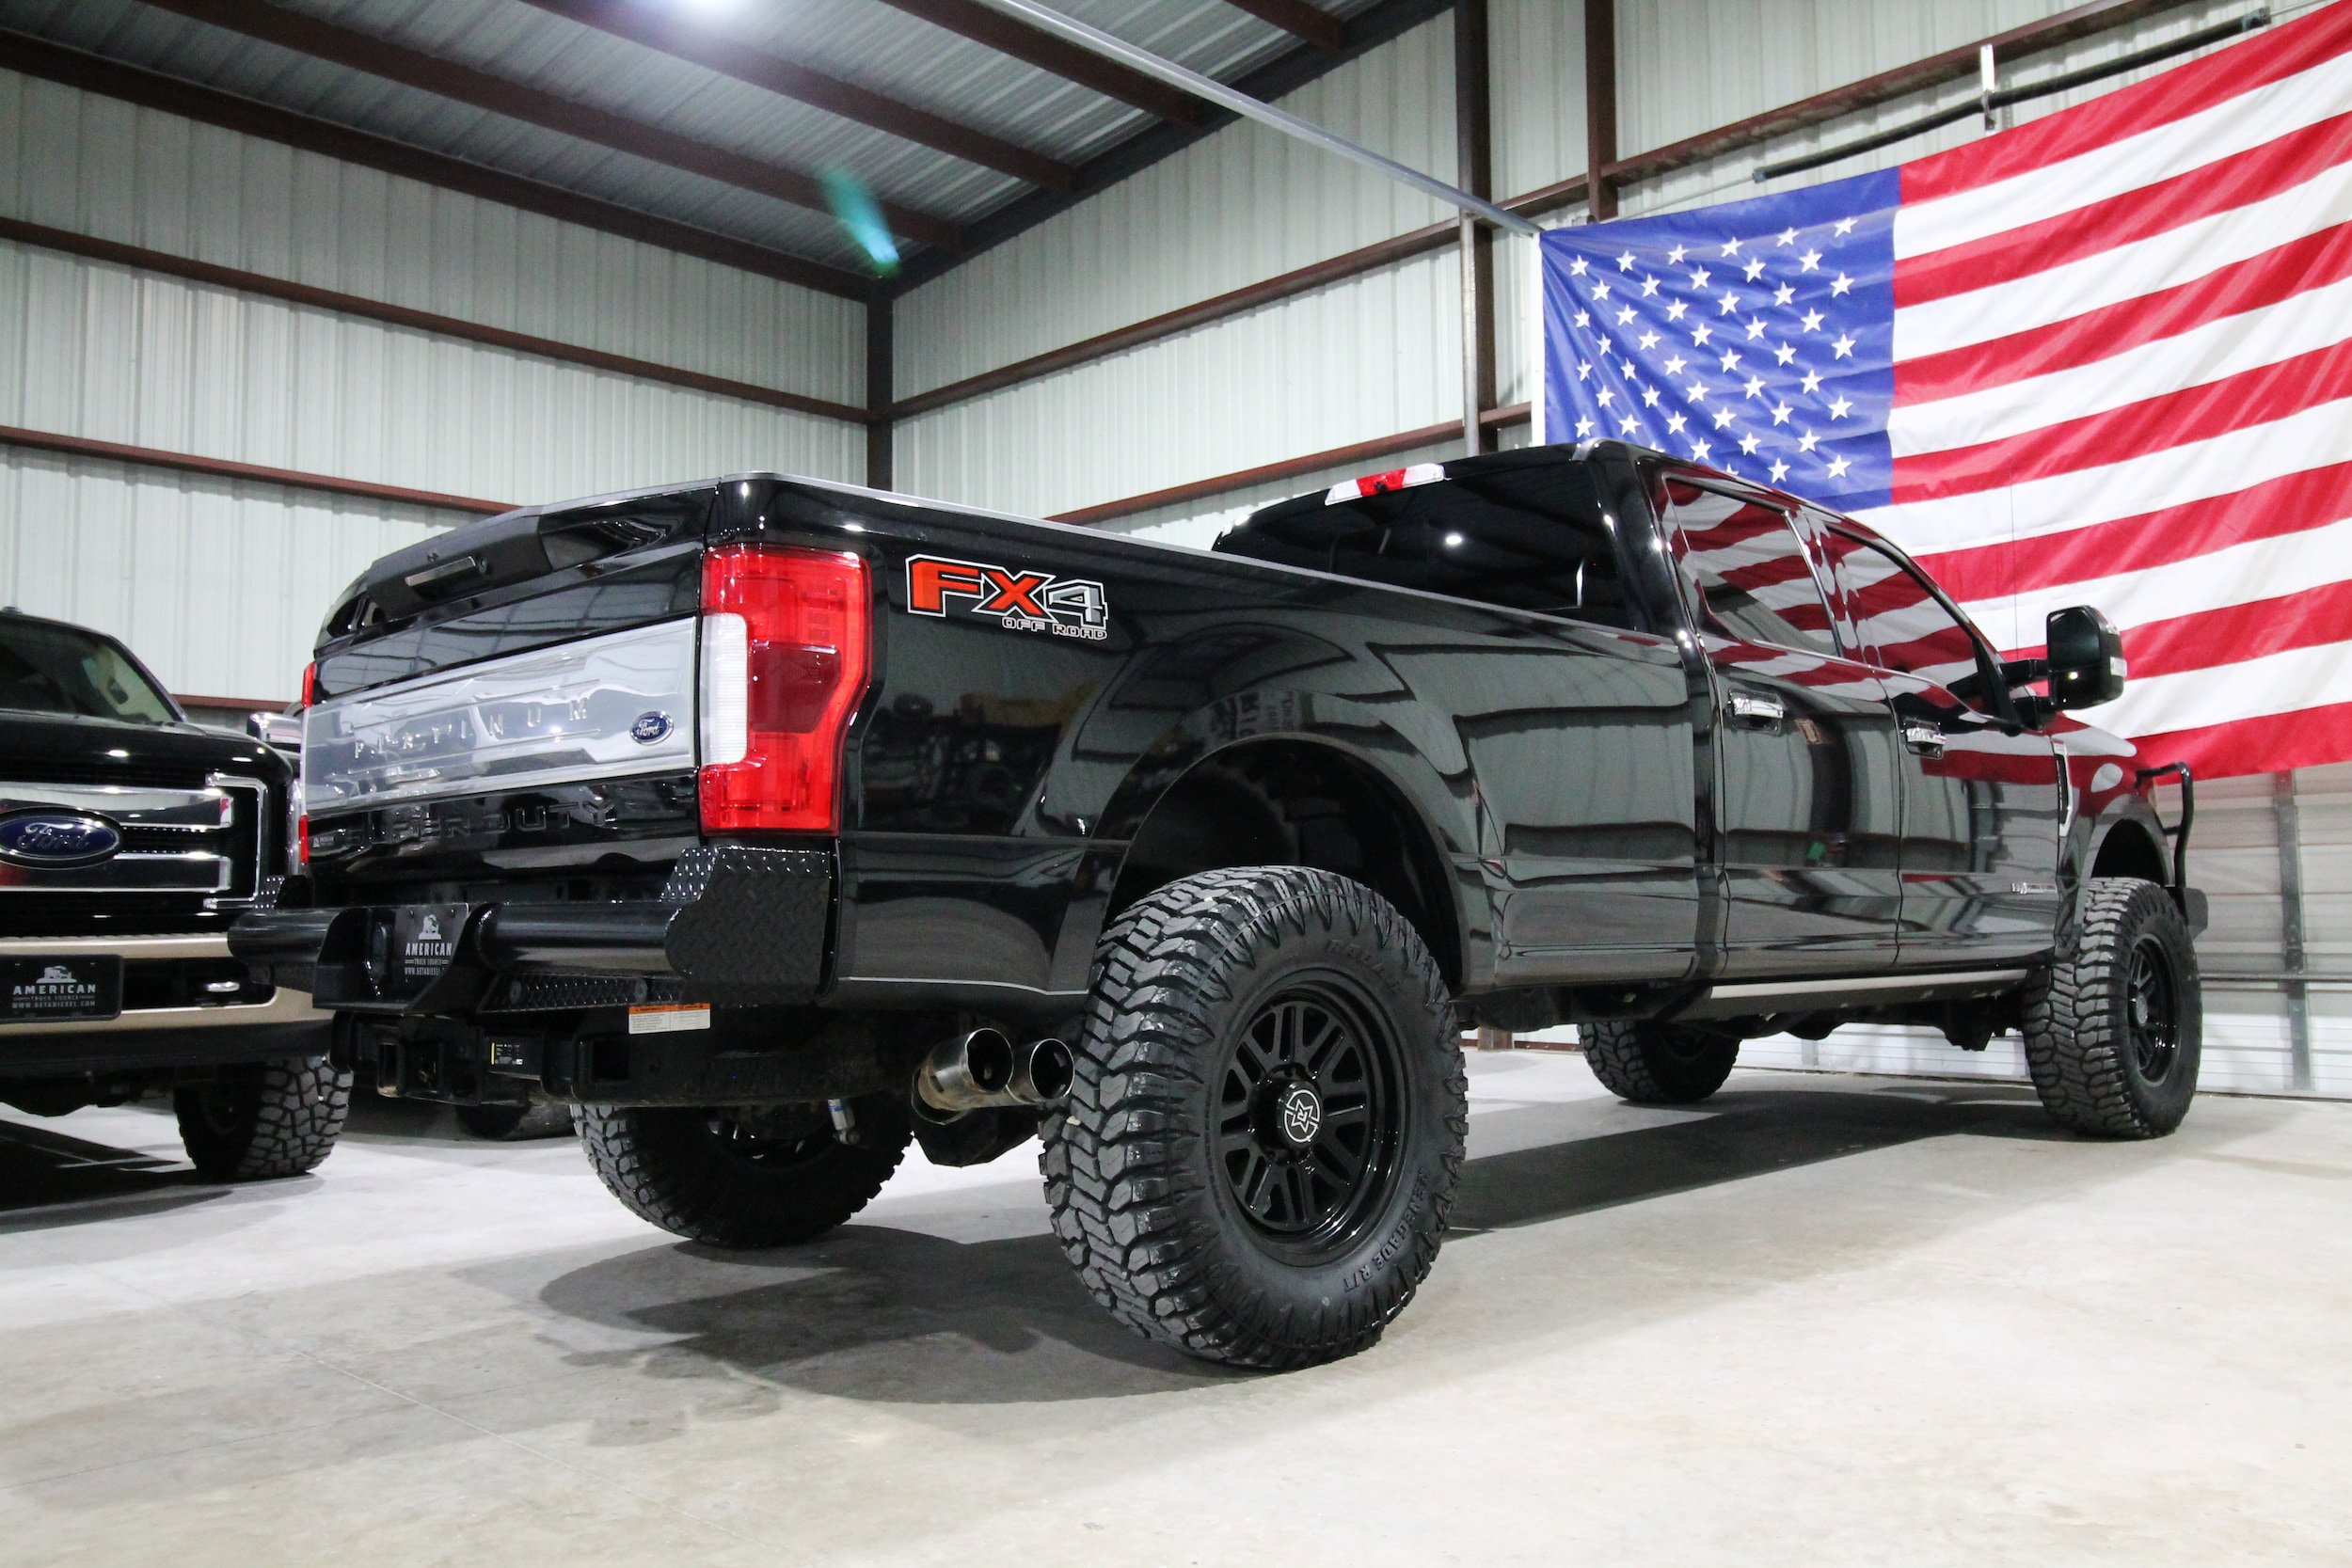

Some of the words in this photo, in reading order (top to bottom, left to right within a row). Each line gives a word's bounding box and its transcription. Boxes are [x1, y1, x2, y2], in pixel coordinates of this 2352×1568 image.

[905, 553, 1109, 630] FX4
[1001, 616, 1046, 632] OFF
[1052, 623, 1108, 641] ROAD
[636, 717, 661, 737] Ford
[16, 821, 92, 849] Ford
[405, 942, 453, 957] AMERICAN
[12, 984, 97, 995] AMERICAN
[1343, 1263, 1374, 1293] R/T
